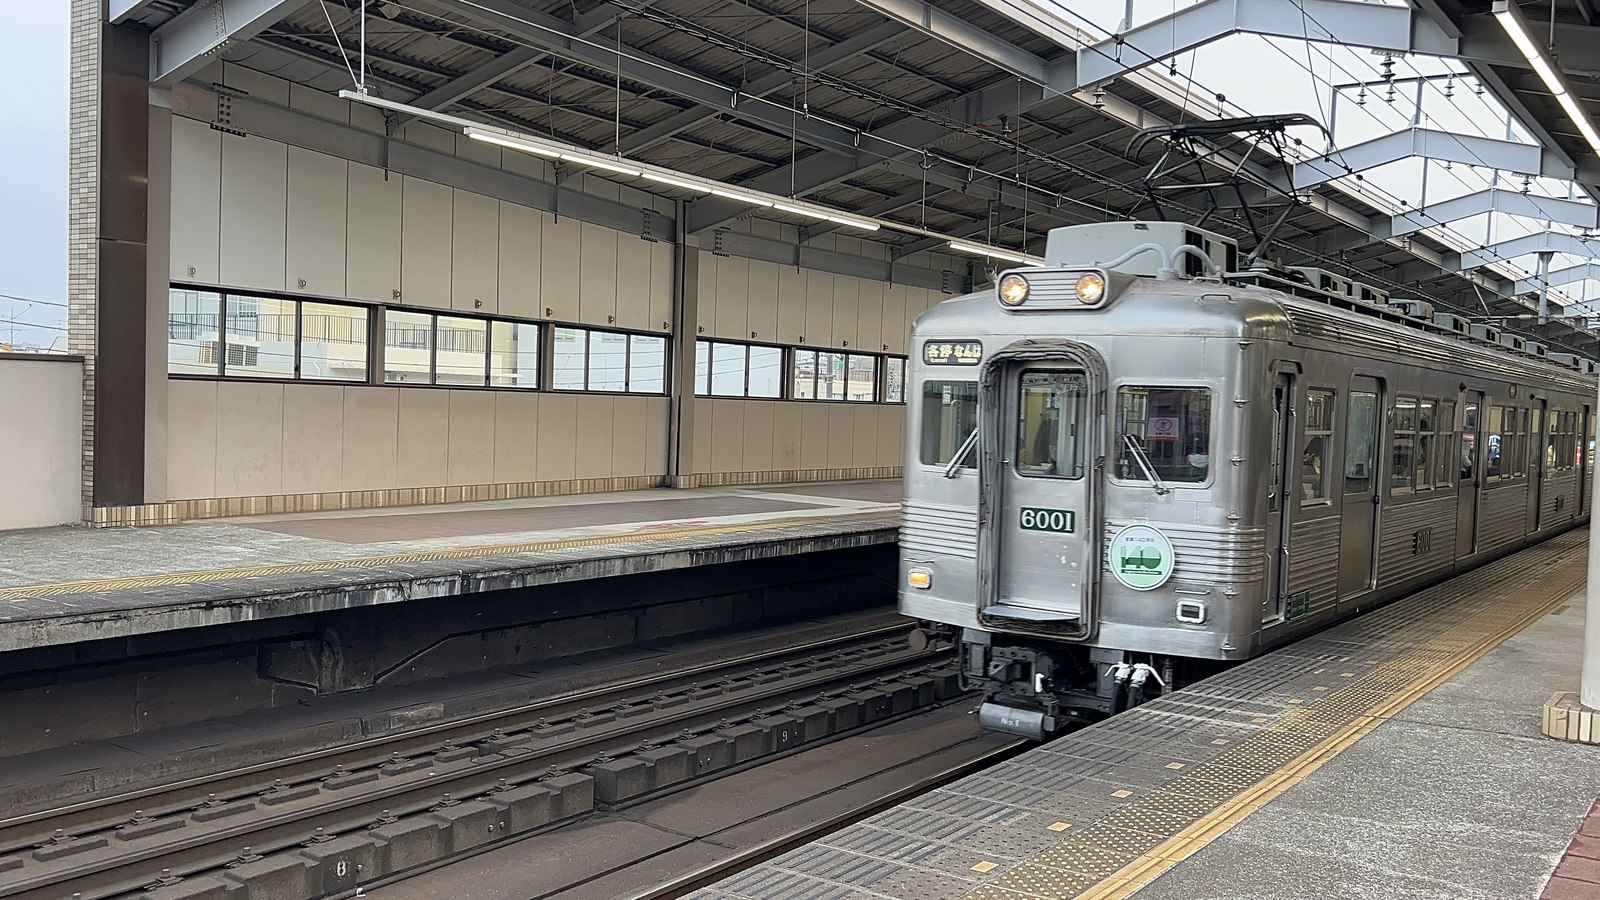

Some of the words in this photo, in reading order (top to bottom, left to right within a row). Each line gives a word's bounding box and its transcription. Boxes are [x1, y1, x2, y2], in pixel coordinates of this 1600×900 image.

[928, 345, 952, 358] 各停
[1021, 509, 1073, 531] 6001
[782, 730, 788, 743] 9
[336, 860, 347, 877] 8
